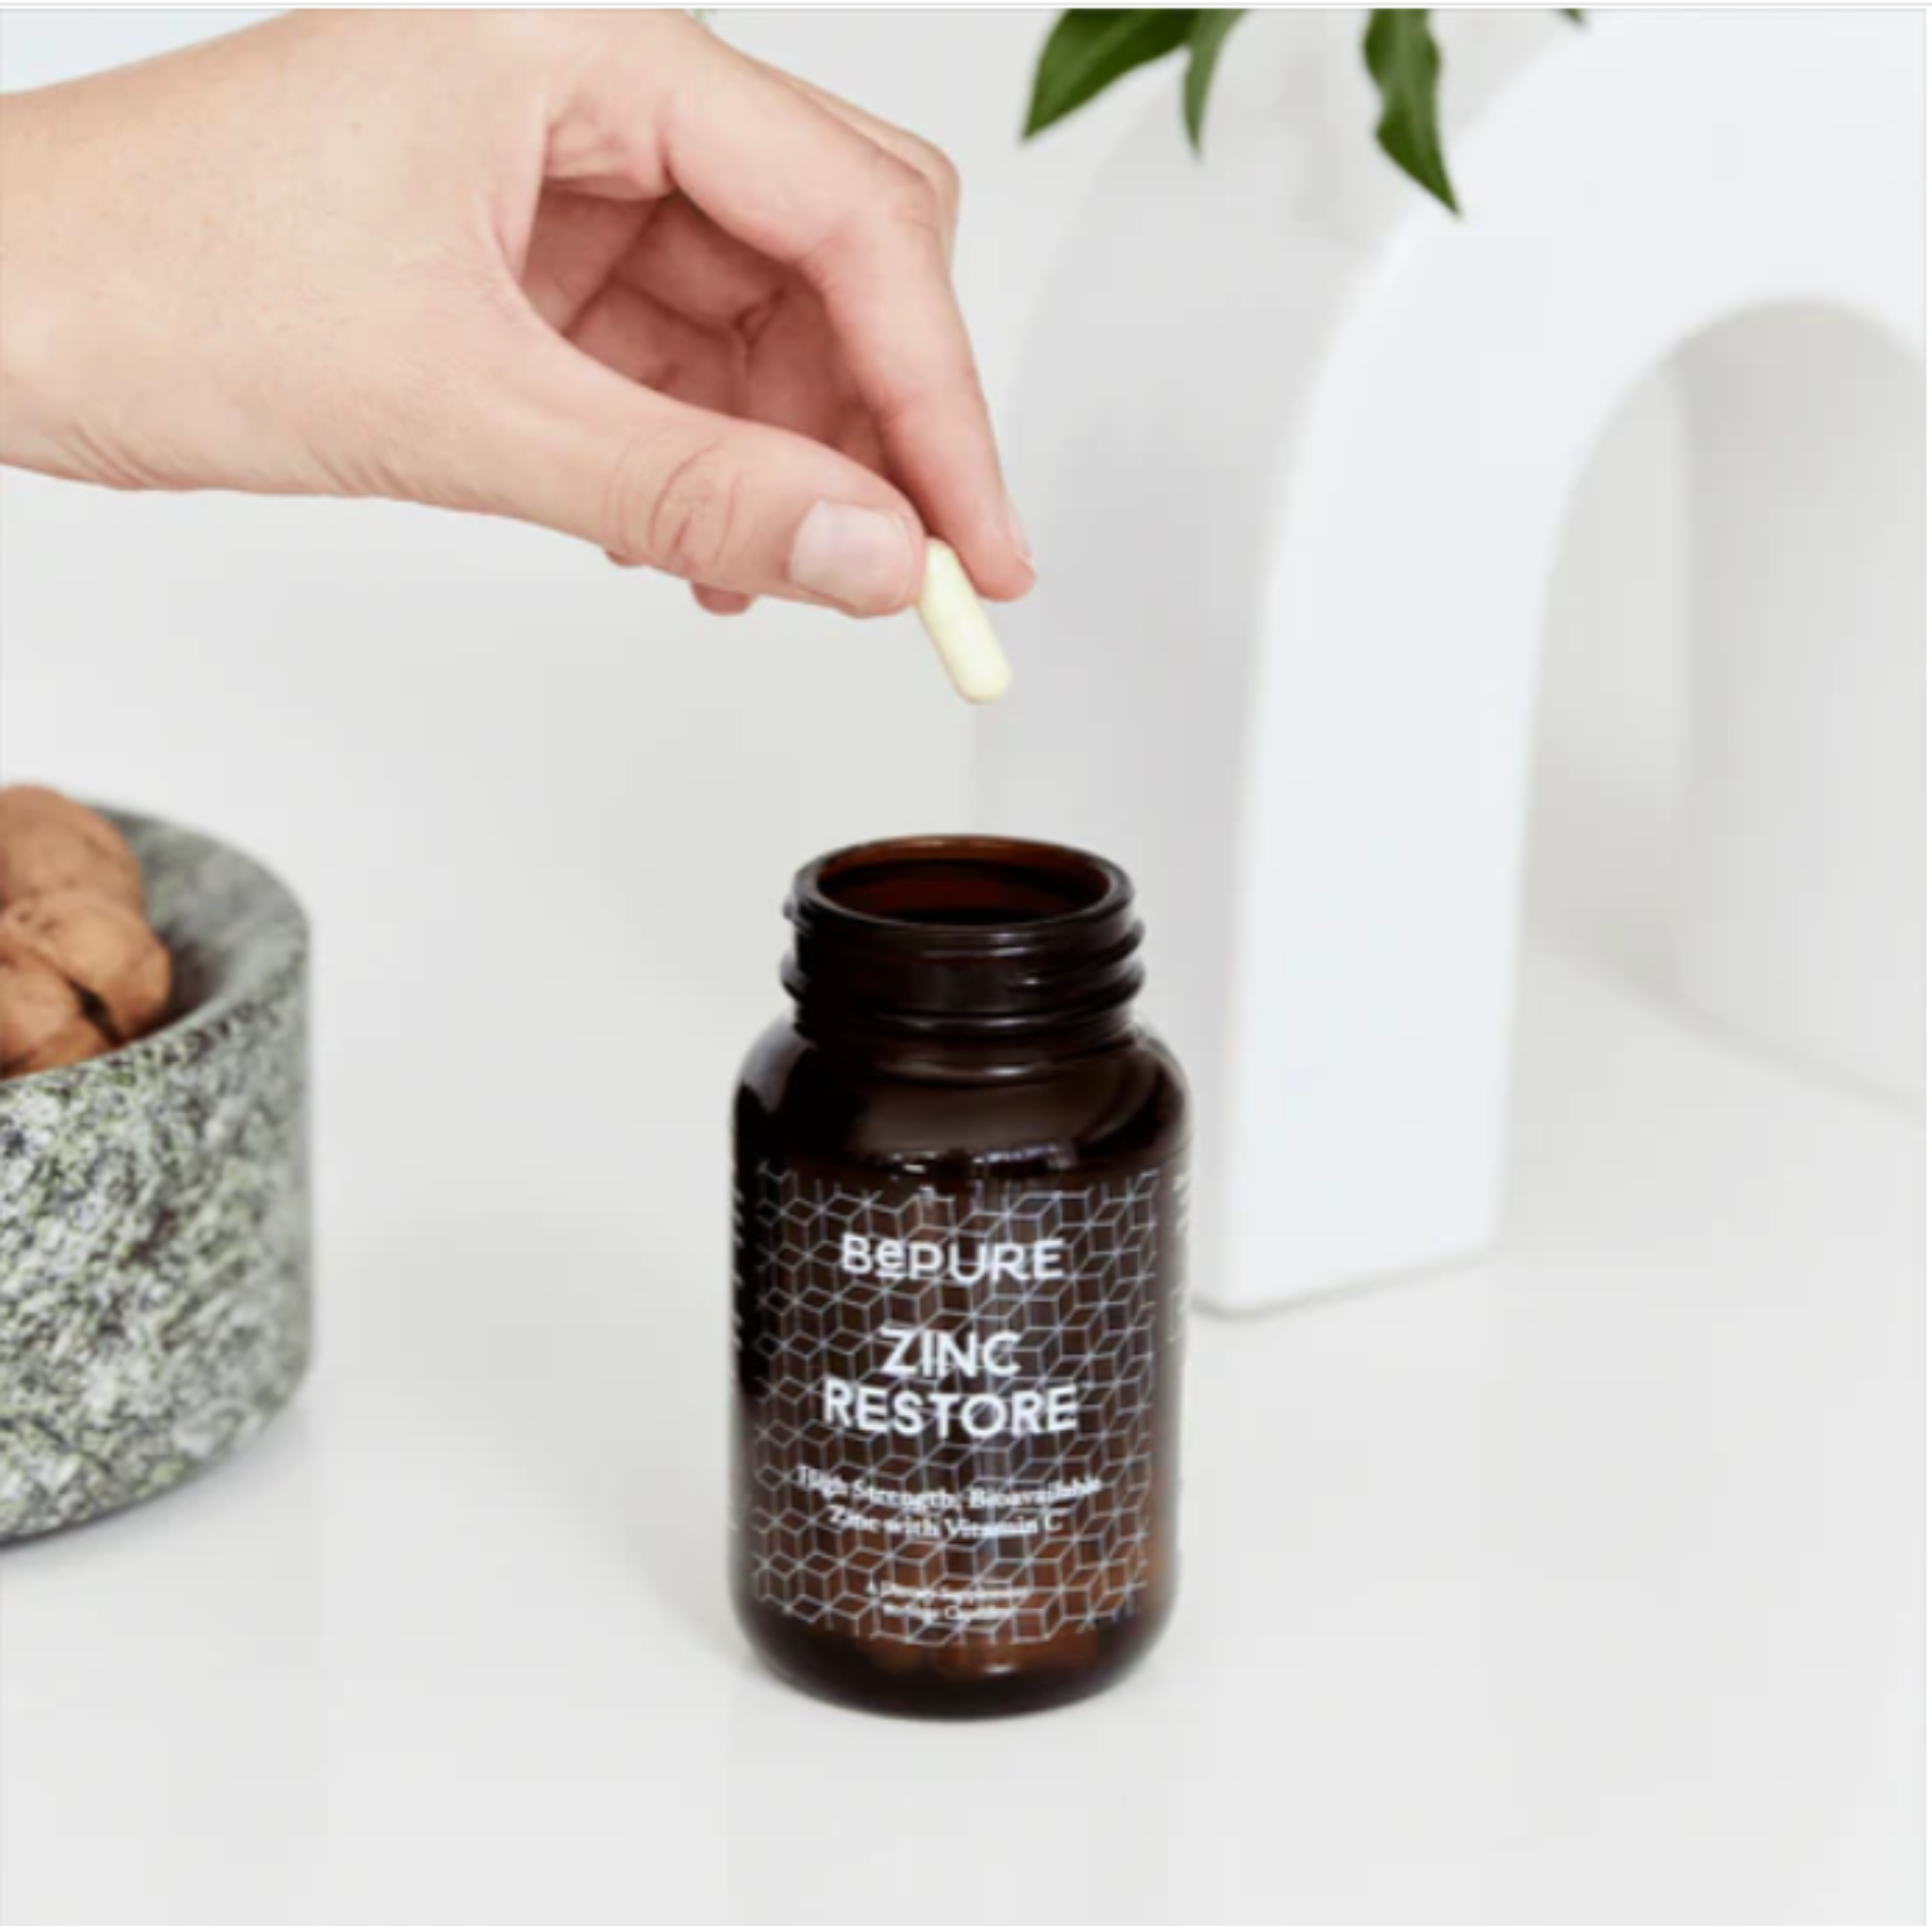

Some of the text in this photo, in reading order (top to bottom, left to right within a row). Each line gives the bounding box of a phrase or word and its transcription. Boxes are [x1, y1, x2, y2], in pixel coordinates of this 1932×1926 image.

[841, 1233, 1065, 1283] BePURE
[878, 1324, 1022, 1379] ZINC
[824, 1374, 1078, 1439] RESTORE
[828, 1504, 879, 1533] Zinc
[1042, 1513, 1064, 1533] C
